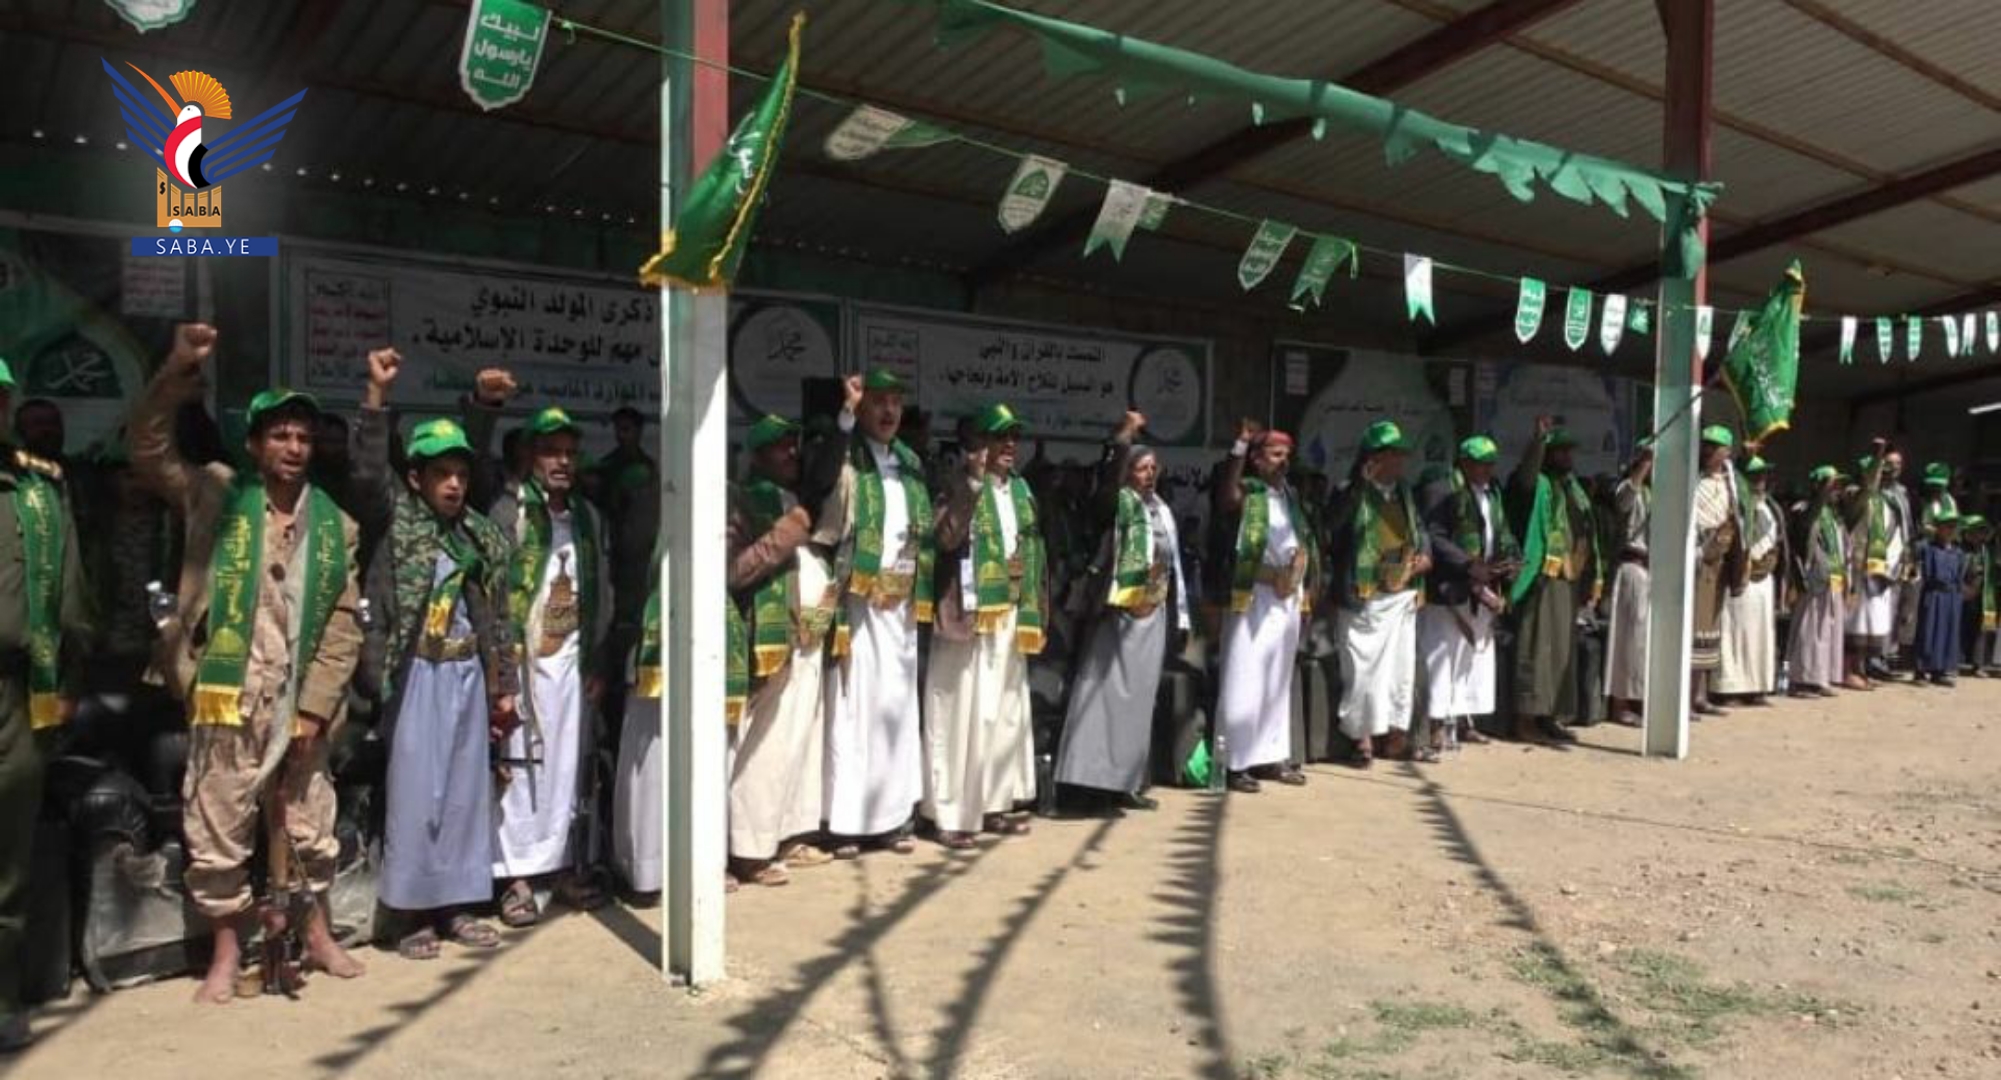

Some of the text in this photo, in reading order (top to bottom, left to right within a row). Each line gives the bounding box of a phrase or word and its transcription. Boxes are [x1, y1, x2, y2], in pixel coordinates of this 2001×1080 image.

[481, 13, 540, 41] لبيك
[470, 284, 654, 326] ذكرى المولد النبوي
[533, 327, 602, 362] للوحدة
[610, 343, 642, 363] مهم
